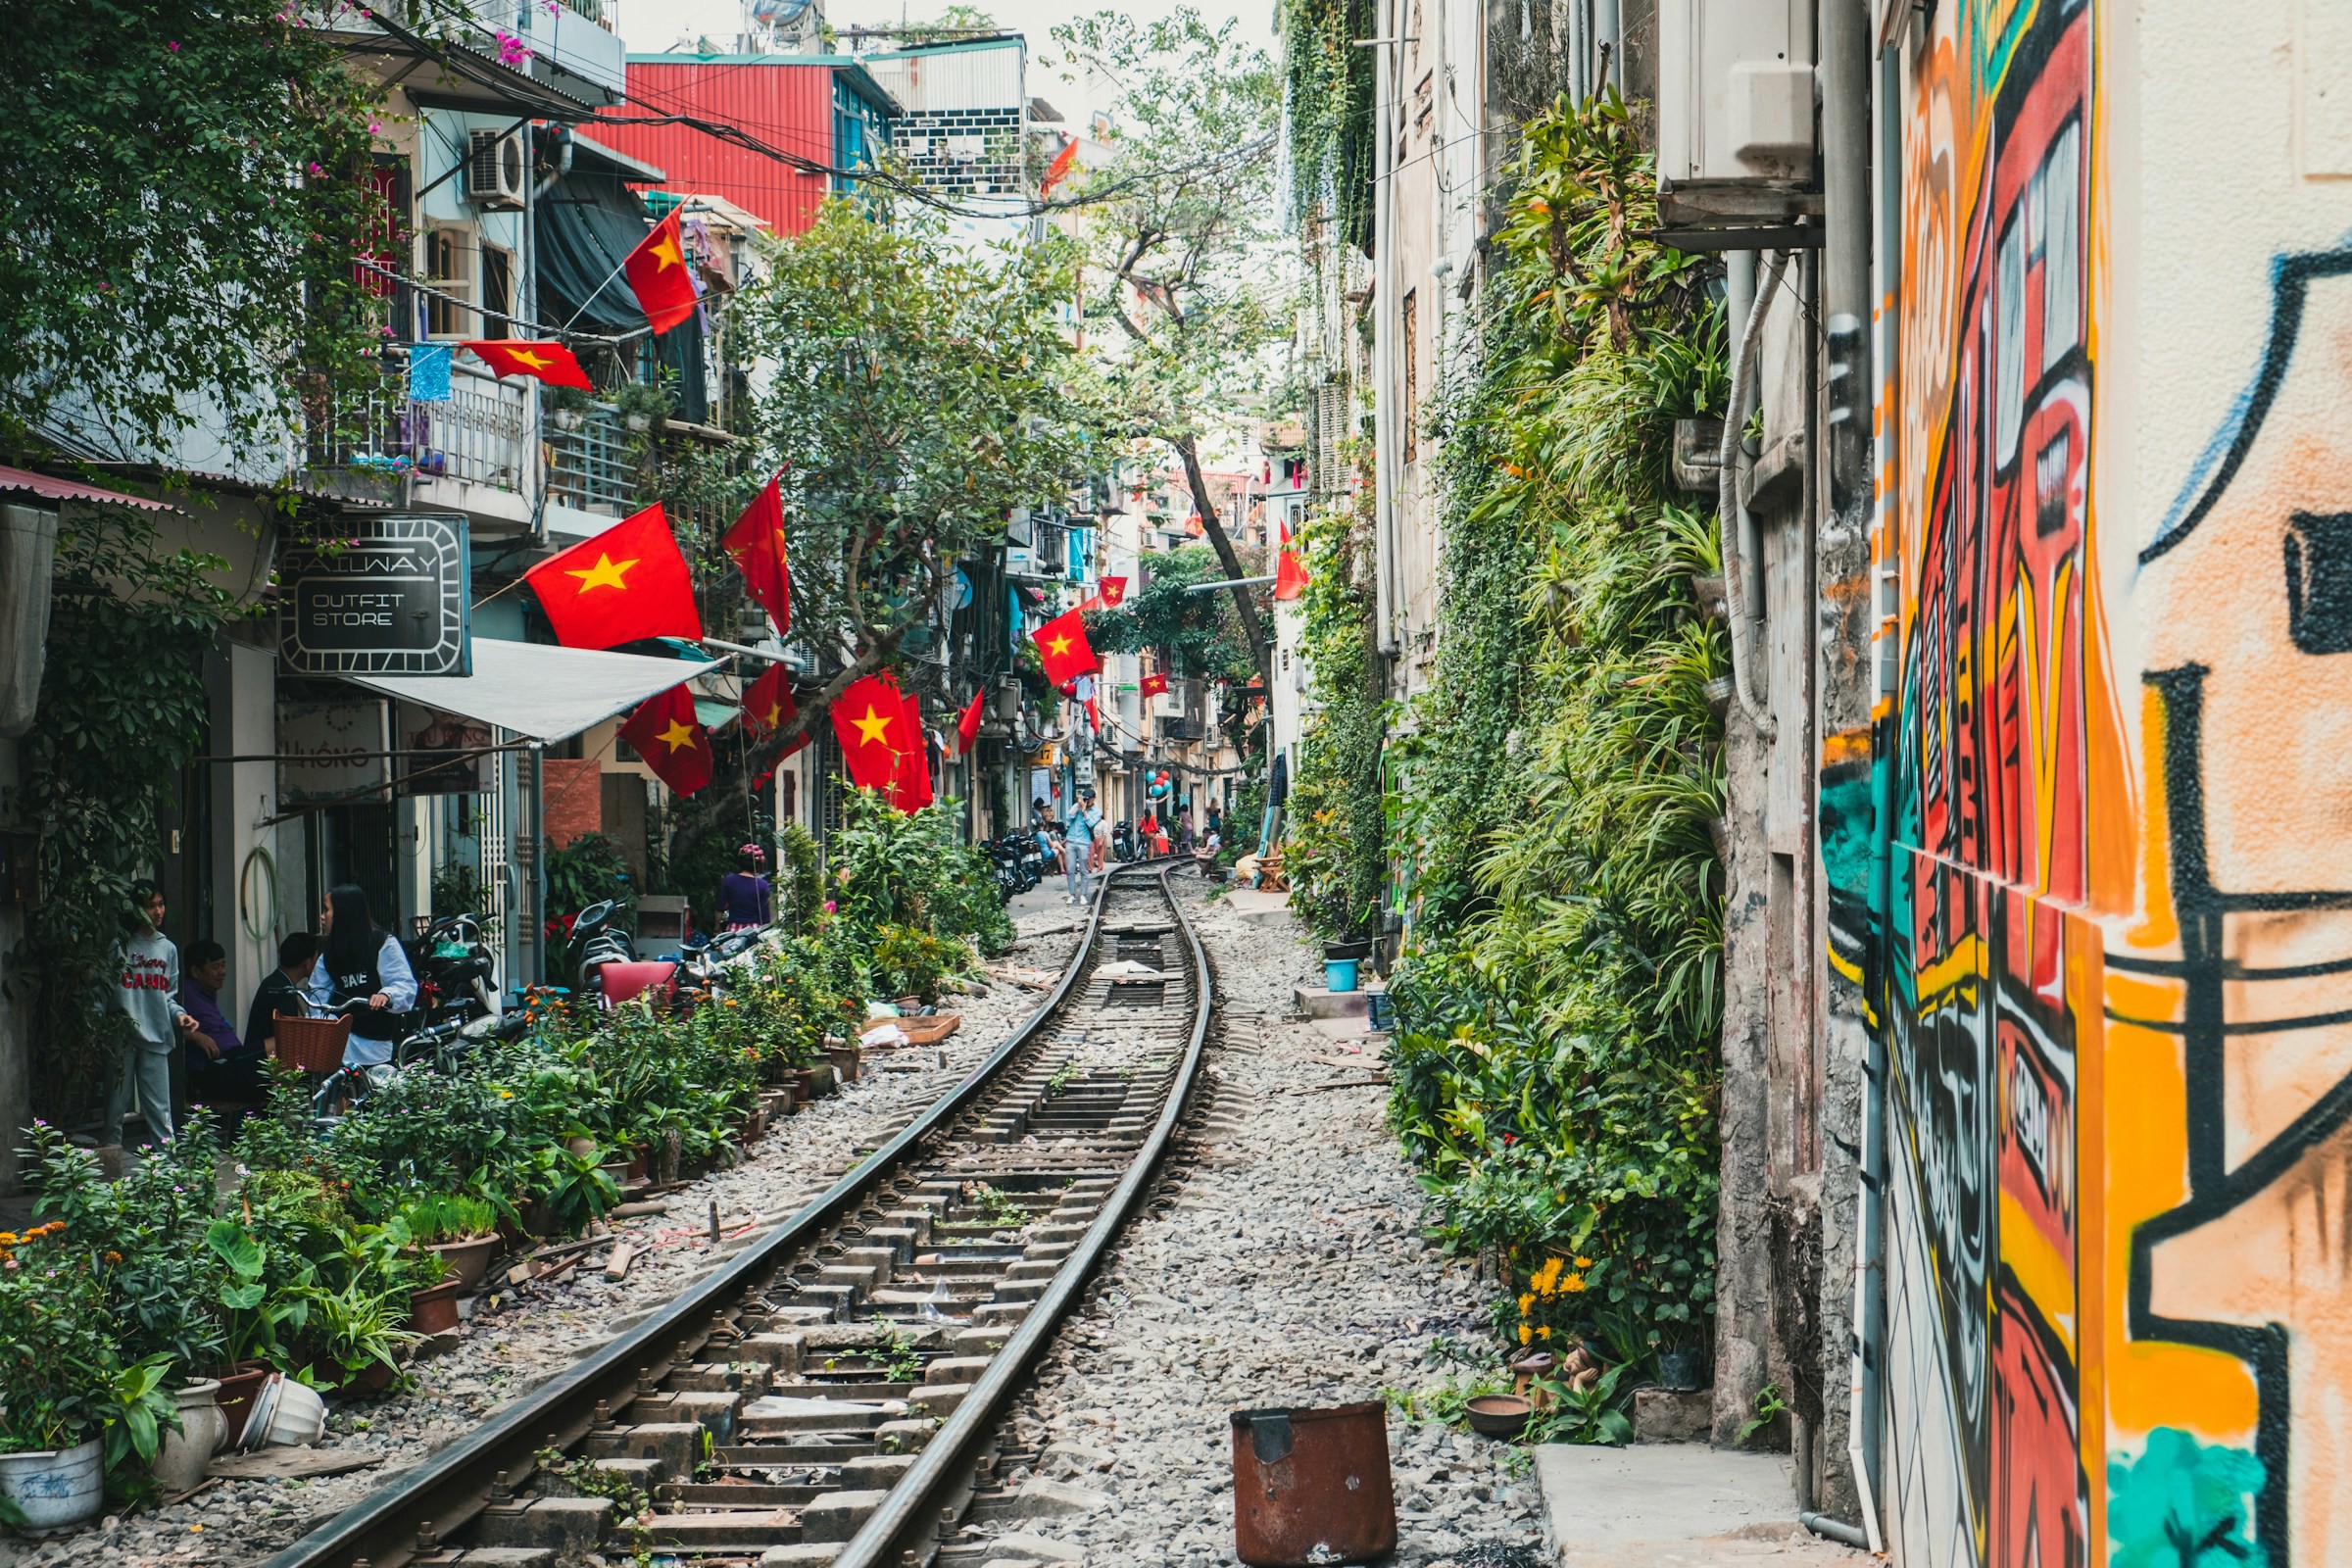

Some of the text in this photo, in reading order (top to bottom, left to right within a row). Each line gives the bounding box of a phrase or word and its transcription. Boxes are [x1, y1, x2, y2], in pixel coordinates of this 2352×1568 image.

[282, 556, 437, 572] RAILWAY
[313, 594, 405, 608] OUTFIT
[313, 612, 393, 626] STORE
[1040, 749, 1051, 760] 17
